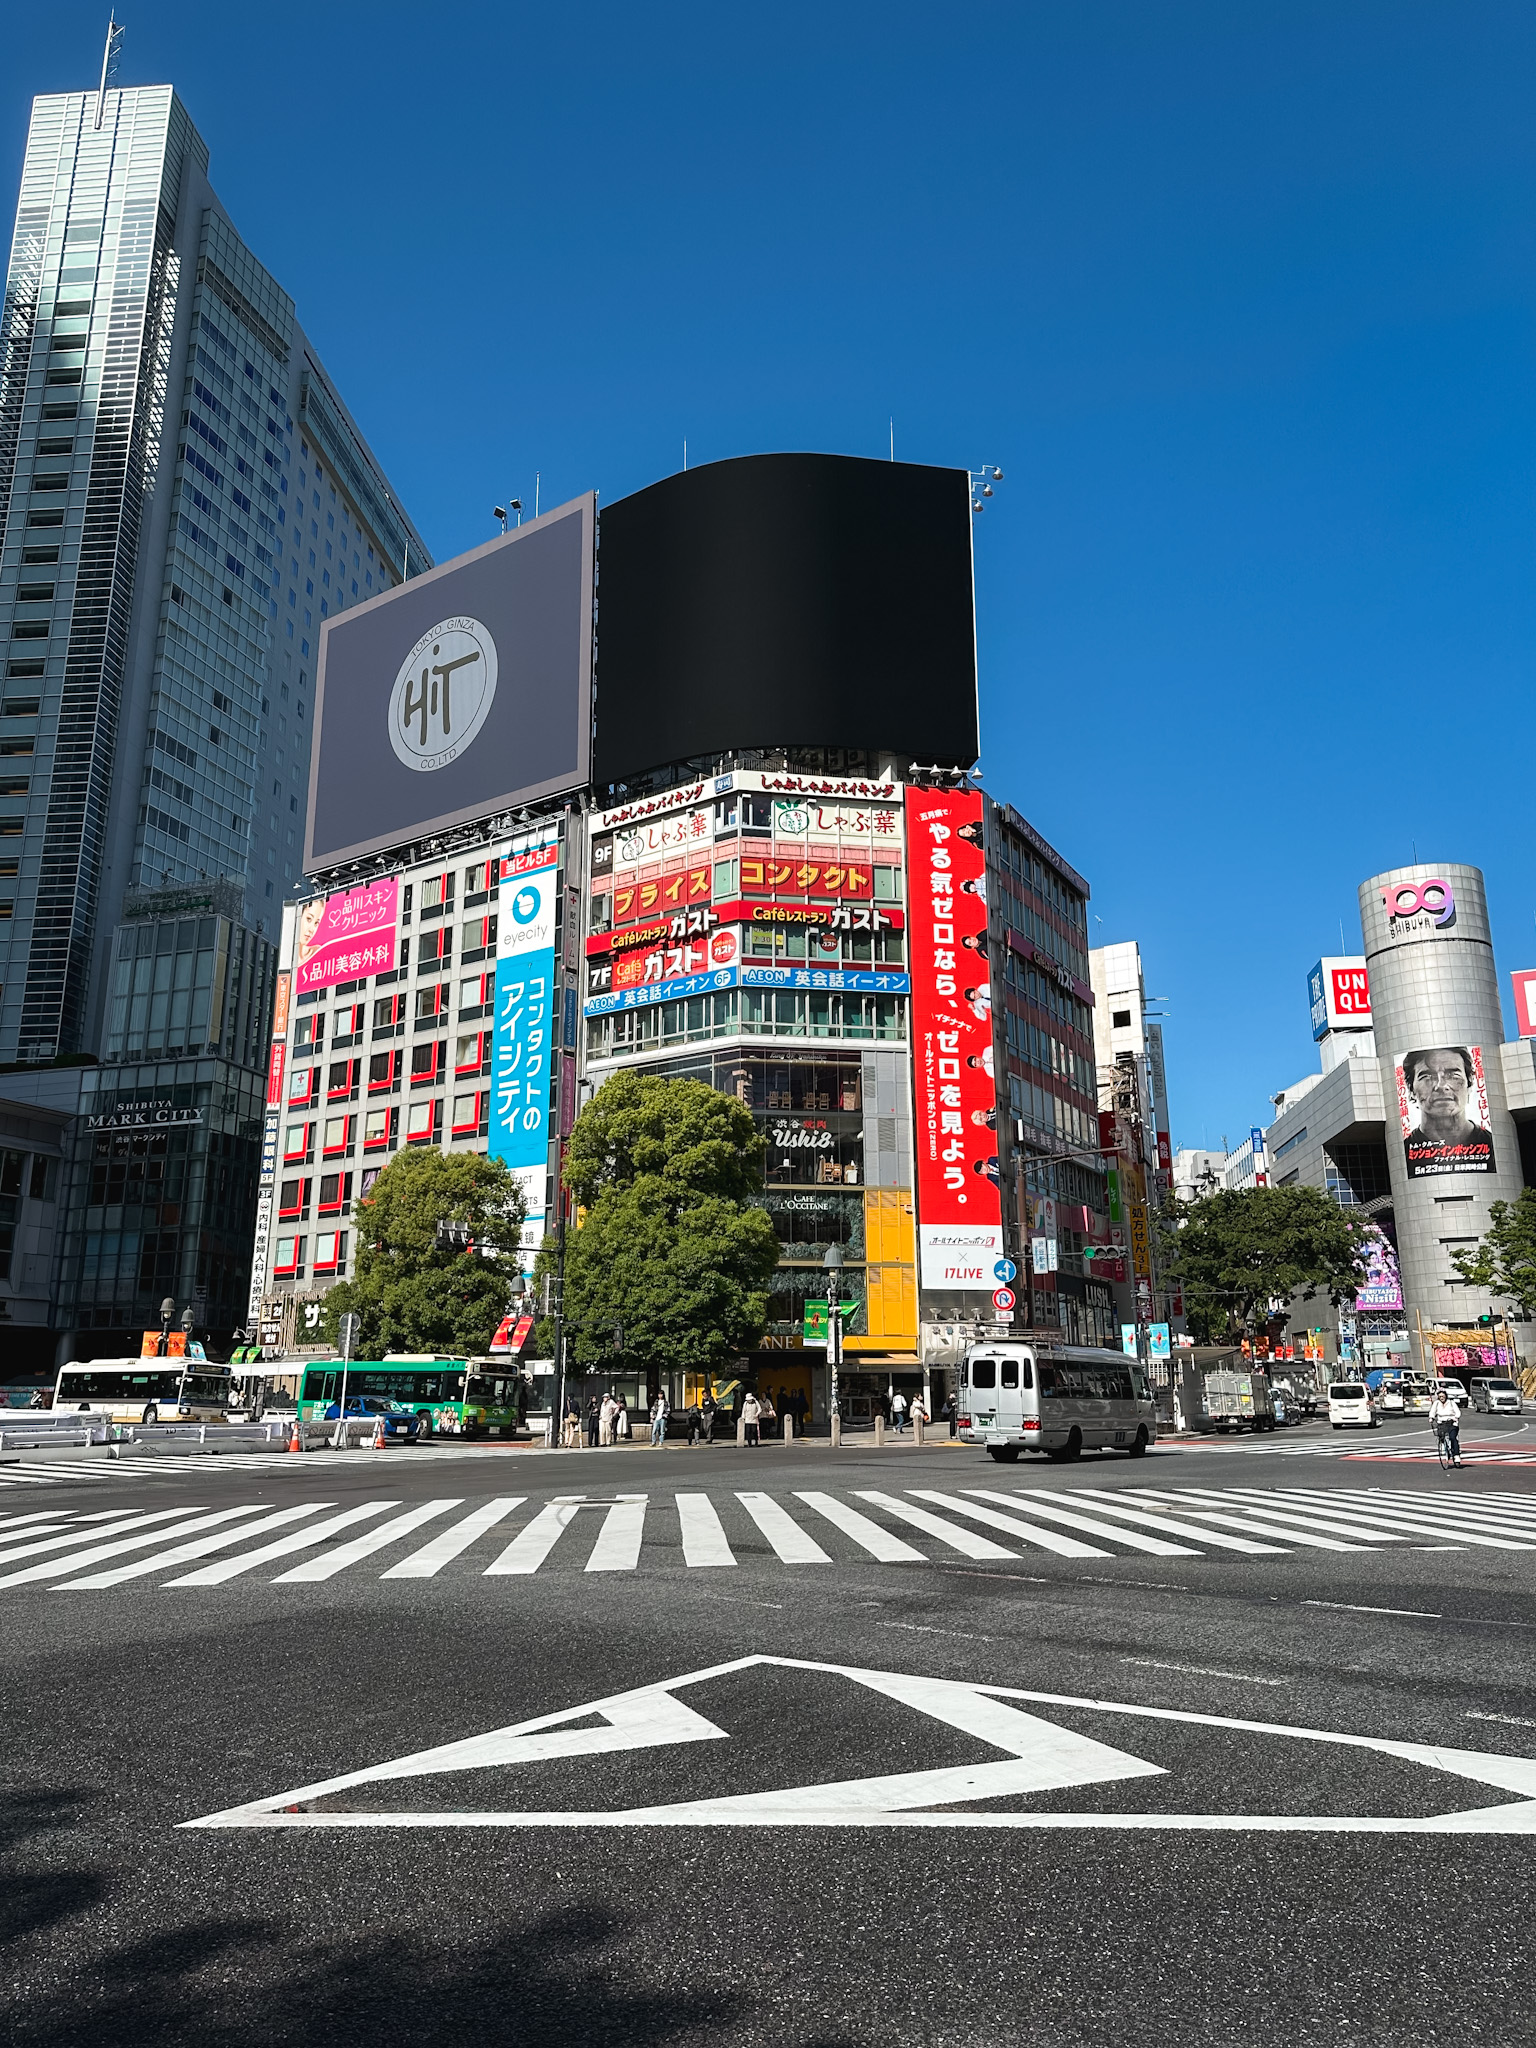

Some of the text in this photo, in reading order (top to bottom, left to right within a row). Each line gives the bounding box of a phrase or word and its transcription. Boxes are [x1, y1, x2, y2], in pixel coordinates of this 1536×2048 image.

[411, 618, 476, 658] TOKYO GINZA
[761, 774, 896, 799] しゃぶしゃぶバイキング
[602, 783, 705, 827] しゃぶしゃぶバイキング
[919, 808, 949, 822] 五月病で
[648, 813, 707, 849] しゃぶ葉
[818, 807, 896, 834] しゃぶ葉
[505, 848, 552, 875] 当ビル5F
[594, 845, 613, 864] 9F
[741, 861, 869, 892] コンタクト
[342, 888, 394, 915] 品川スキン
[615, 869, 711, 916] プライス
[1378, 878, 1455, 926] 109
[341, 905, 387, 931] クリニック
[670, 908, 719, 940] ガスト
[831, 906, 890, 932] ガスト
[1388, 917, 1431, 939] SHIBUYA
[503, 924, 548, 948] eyecity
[714, 944, 735, 956] ガスト
[309, 943, 390, 983] 品川美容外科
[616, 959, 642, 977] Café
[644, 945, 703, 983] ガスト
[590, 965, 612, 988] 7F
[747, 969, 907, 990] AEON 英会話イーオン
[1311, 972, 1322, 1002] THE
[1337, 973, 1366, 990] UN
[587, 971, 730, 1012] AEON 英会話イーオン 6F
[276, 984, 288, 1032] 東京スター銀行
[934, 1013, 973, 1033] イチナナで
[272, 1045, 283, 1077] 外貨両替
[497, 981, 525, 1134] アイシティ
[522, 976, 545, 1131] コンタクトの
[1471, 1046, 1492, 1131] 僕を信じてほしい
[87, 1108, 204, 1128] MARK CITY
[117, 1099, 172, 1112] SHIBUYA
[936, 1030, 968, 1204] ゼロを見よう。
[776, 1119, 827, 1130] 渋谷 焼肉
[115, 1133, 167, 1144] 渋谷 マークシティ
[262, 1117, 278, 1172] 加藤眼科
[1159, 1141, 1169, 1159] 免税
[1408, 1139, 1446, 1149] トム・クルーズ
[1434, 1153, 1491, 1163] ファイナル・レコニング
[262, 1174, 272, 1182] 5F
[260, 1190, 272, 1199] 3F
[780, 1199, 829, 1210] L'OCCITANE
[257, 1213, 269, 1231] 内科
[1131, 1207, 1148, 1254] 処方せん
[945, 1268, 983, 1279] 17LIVE
[1137, 1255, 1146, 1272] 3F
[1085, 1284, 1108, 1309] LUSH
[1365, 1294, 1398, 1303] NiziU
